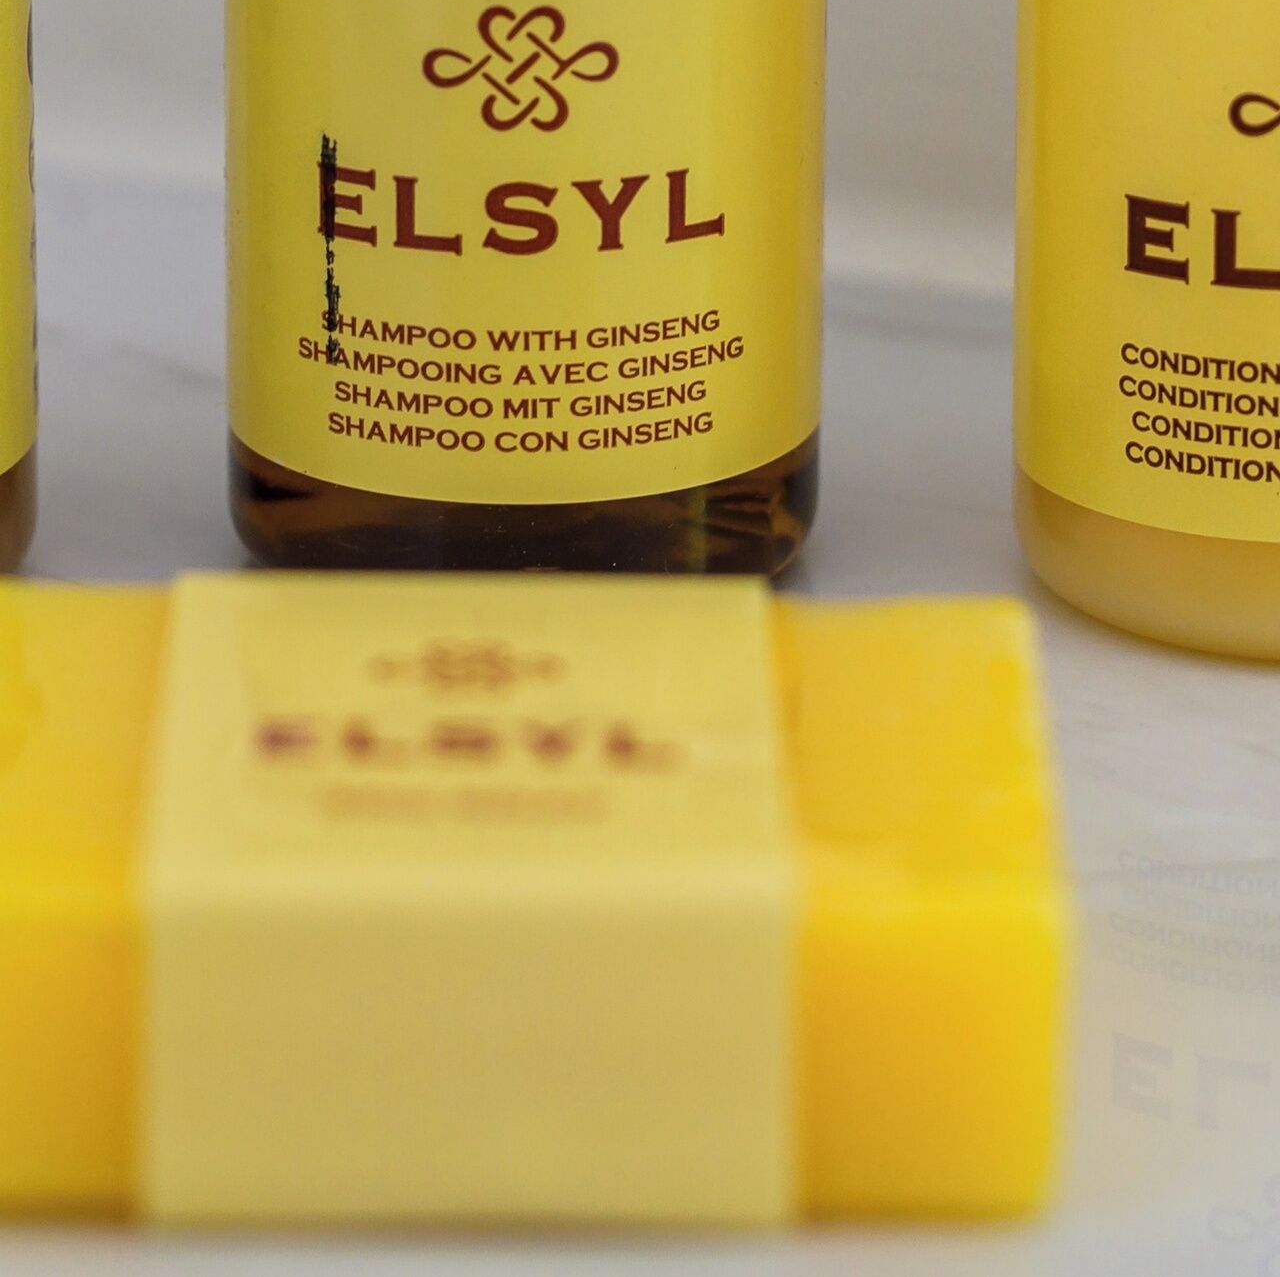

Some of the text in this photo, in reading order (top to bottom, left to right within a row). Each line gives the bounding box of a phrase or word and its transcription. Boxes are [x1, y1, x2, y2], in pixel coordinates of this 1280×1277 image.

[317, 161, 725, 257] ELSYL
[487, 330, 577, 352] WITH
[586, 310, 720, 349] GINSENG
[298, 336, 744, 386] SHAMPOOING AVEC GINSENG
[335, 380, 707, 420] SHAMPOO MIT GINSENG
[327, 411, 713, 453] SHAMPOO CON GINSENG
